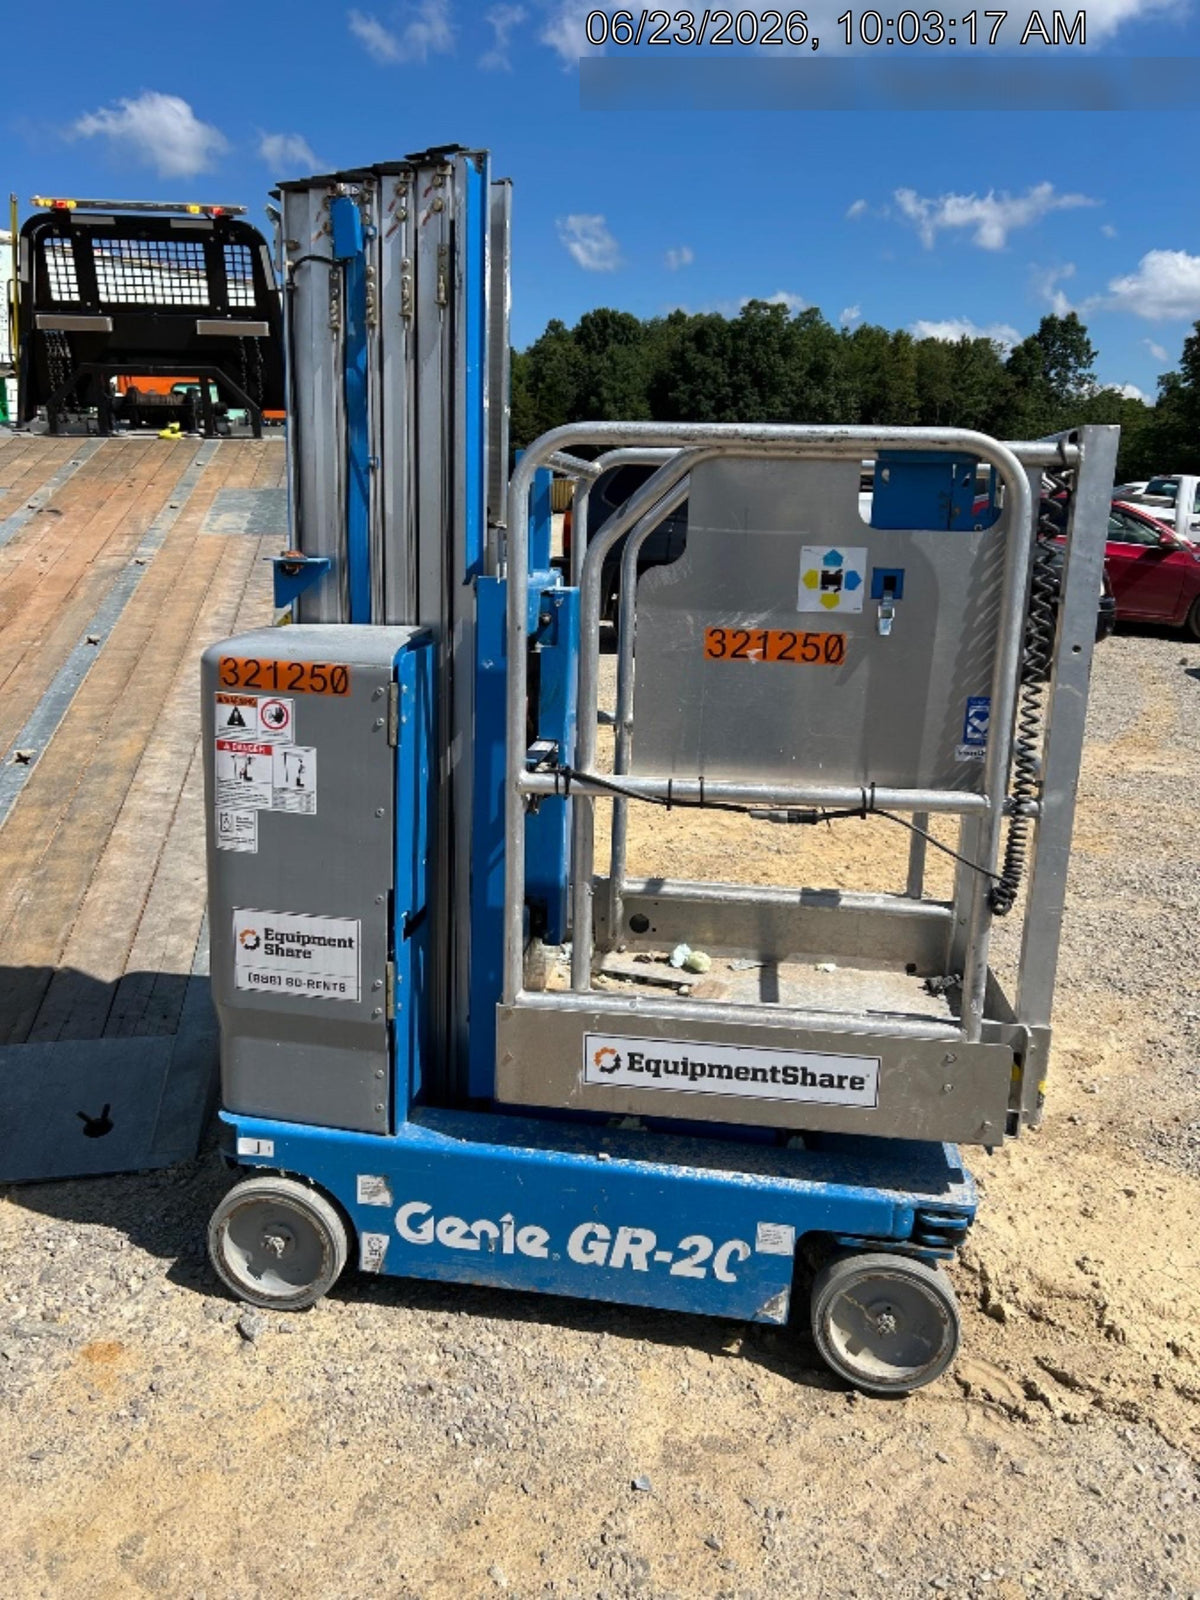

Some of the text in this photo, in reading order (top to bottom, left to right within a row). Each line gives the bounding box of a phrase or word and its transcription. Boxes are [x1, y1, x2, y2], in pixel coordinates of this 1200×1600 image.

[708, 629, 844, 663] 321250
[222, 658, 349, 694] 321250
[264, 927, 355, 949] Equipment
[264, 944, 312, 959] Share
[626, 1051, 867, 1092] EquipmentShare
[393, 1200, 551, 1260] Genie
